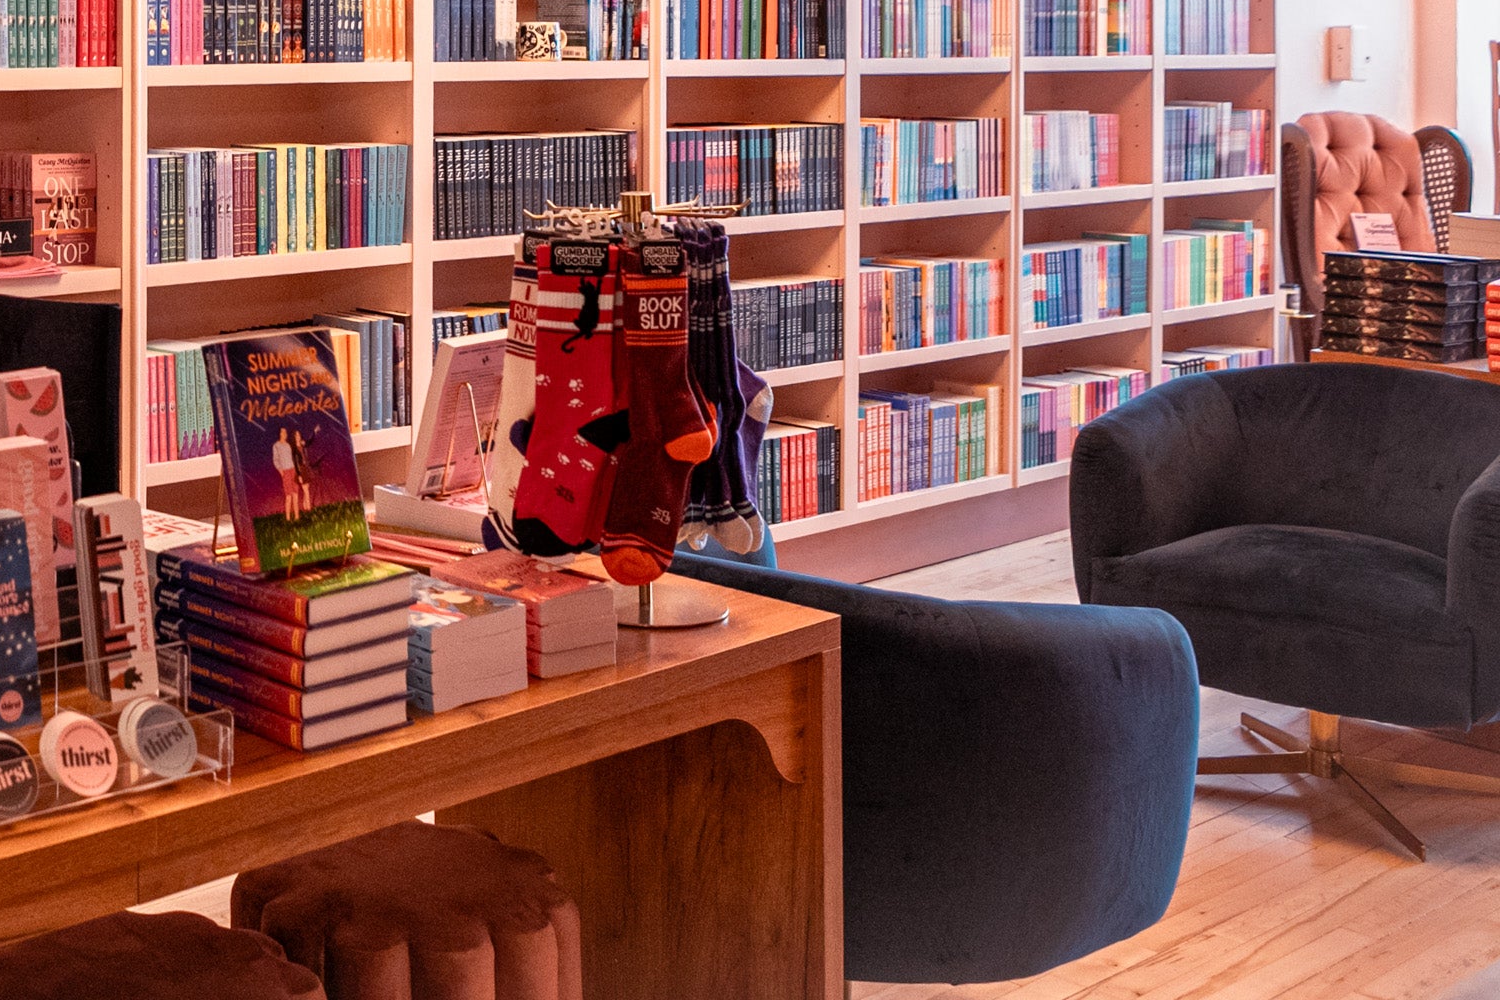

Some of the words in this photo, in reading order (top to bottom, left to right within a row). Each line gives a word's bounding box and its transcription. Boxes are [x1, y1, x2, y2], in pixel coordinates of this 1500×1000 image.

[44, 177, 85, 197] ONE
[41, 208, 92, 231] LAST
[42, 242, 89, 264] STOP
[554, 246, 604, 258] GUMBALL
[556, 256, 602, 266] POODLE
[638, 296, 683, 313] BOOK
[640, 313, 681, 329] SLUT
[247, 346, 318, 373] SUMMER
[247, 371, 308, 395] NIGHTS
[310, 372, 333, 386] AND
[240, 390, 340, 422] Meteorites
[143, 721, 189, 761] thirst
[61, 748, 112, 768] thirst
